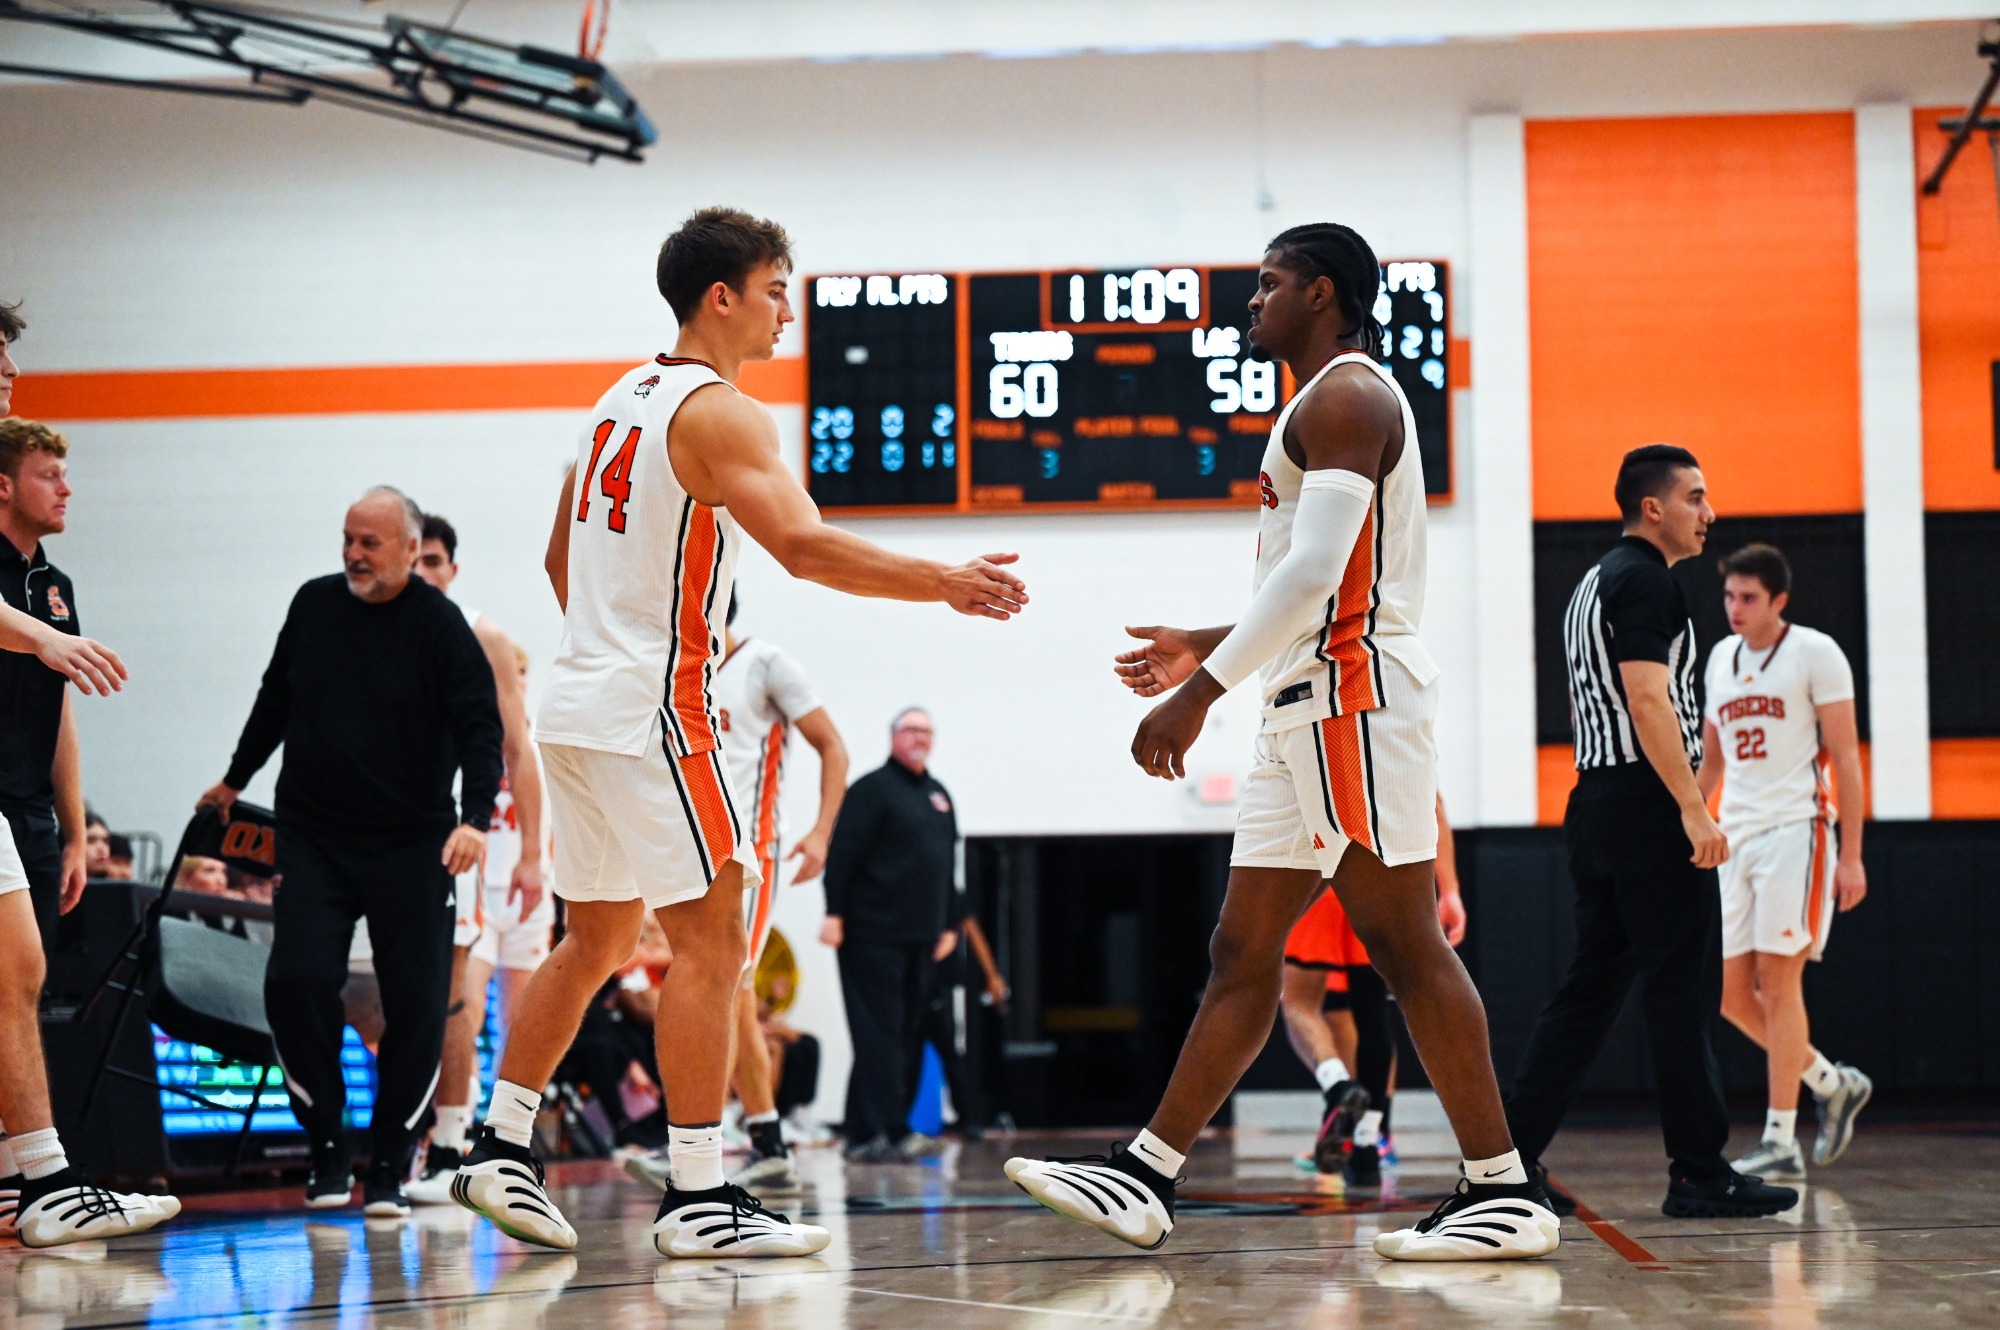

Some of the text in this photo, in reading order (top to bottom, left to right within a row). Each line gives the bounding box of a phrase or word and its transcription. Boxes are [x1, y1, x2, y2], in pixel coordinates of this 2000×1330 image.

[1070, 269, 1200, 324] 11:09
[989, 363, 1059, 418] 60
[1207, 358, 1276, 413] 58
[932, 402, 955, 438] 2
[577, 418, 643, 535] 14
[811, 440, 854, 474] 22
[1717, 695, 1786, 727] TIGERS
[1734, 727, 1768, 760] 22
